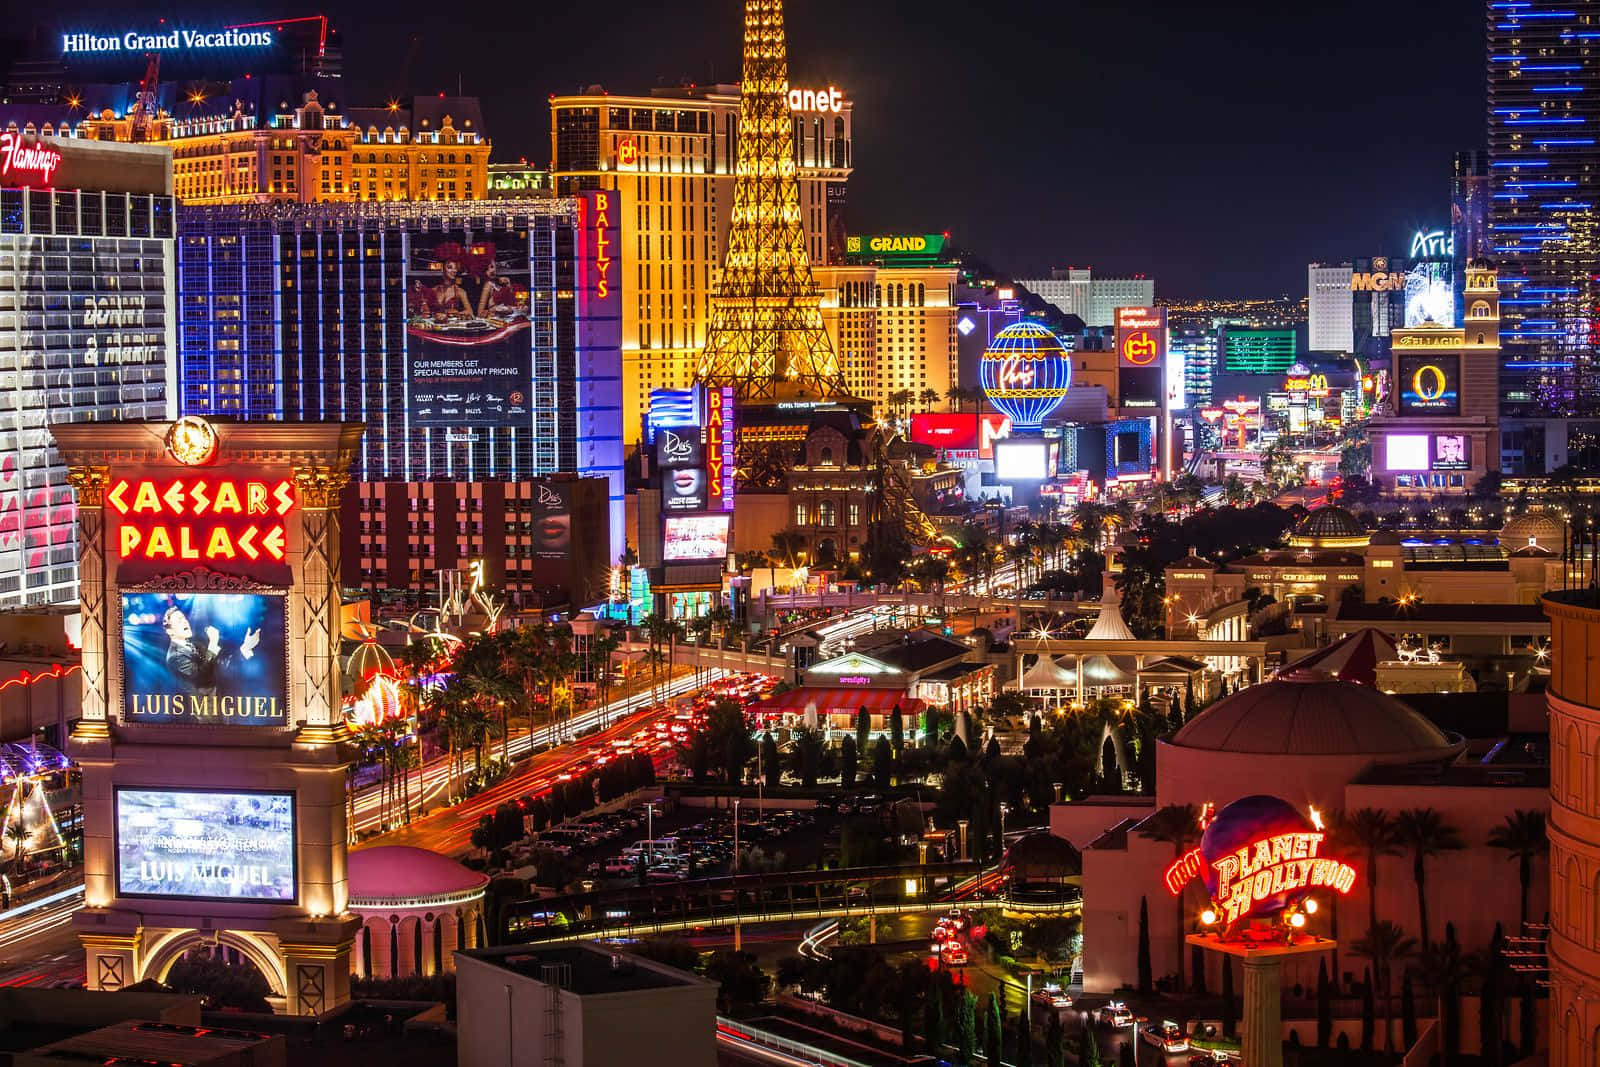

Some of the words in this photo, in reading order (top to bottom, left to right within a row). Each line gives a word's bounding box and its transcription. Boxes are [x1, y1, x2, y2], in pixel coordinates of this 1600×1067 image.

[63, 33, 121, 53] Hilton
[124, 30, 180, 50] Grand
[182, 28, 272, 48] Vacations
[0, 132, 61, 183] Flamingo
[870, 236, 926, 253] GRAND
[1119, 307, 1148, 319] planet
[1119, 318, 1160, 329] hollywood
[1400, 335, 1463, 346] BELLAGIO
[413, 368, 441, 377] SPECIAL
[442, 368, 488, 376] RESTAURANT
[430, 360, 464, 369] MEMBERS
[999, 353, 1034, 394] Paris
[1412, 365, 1446, 400] O
[956, 451, 977, 459] MILE
[107, 480, 295, 516] CAESARS
[119, 525, 286, 561] PALACE
[131, 693, 185, 716] LUIS
[190, 694, 283, 719] MIGUEL
[140, 860, 185, 882] LUIS
[190, 862, 274, 886] MIGUEL
[1212, 832, 1324, 900] PLANET
[1221, 858, 1358, 924] HOLLYWOOD
